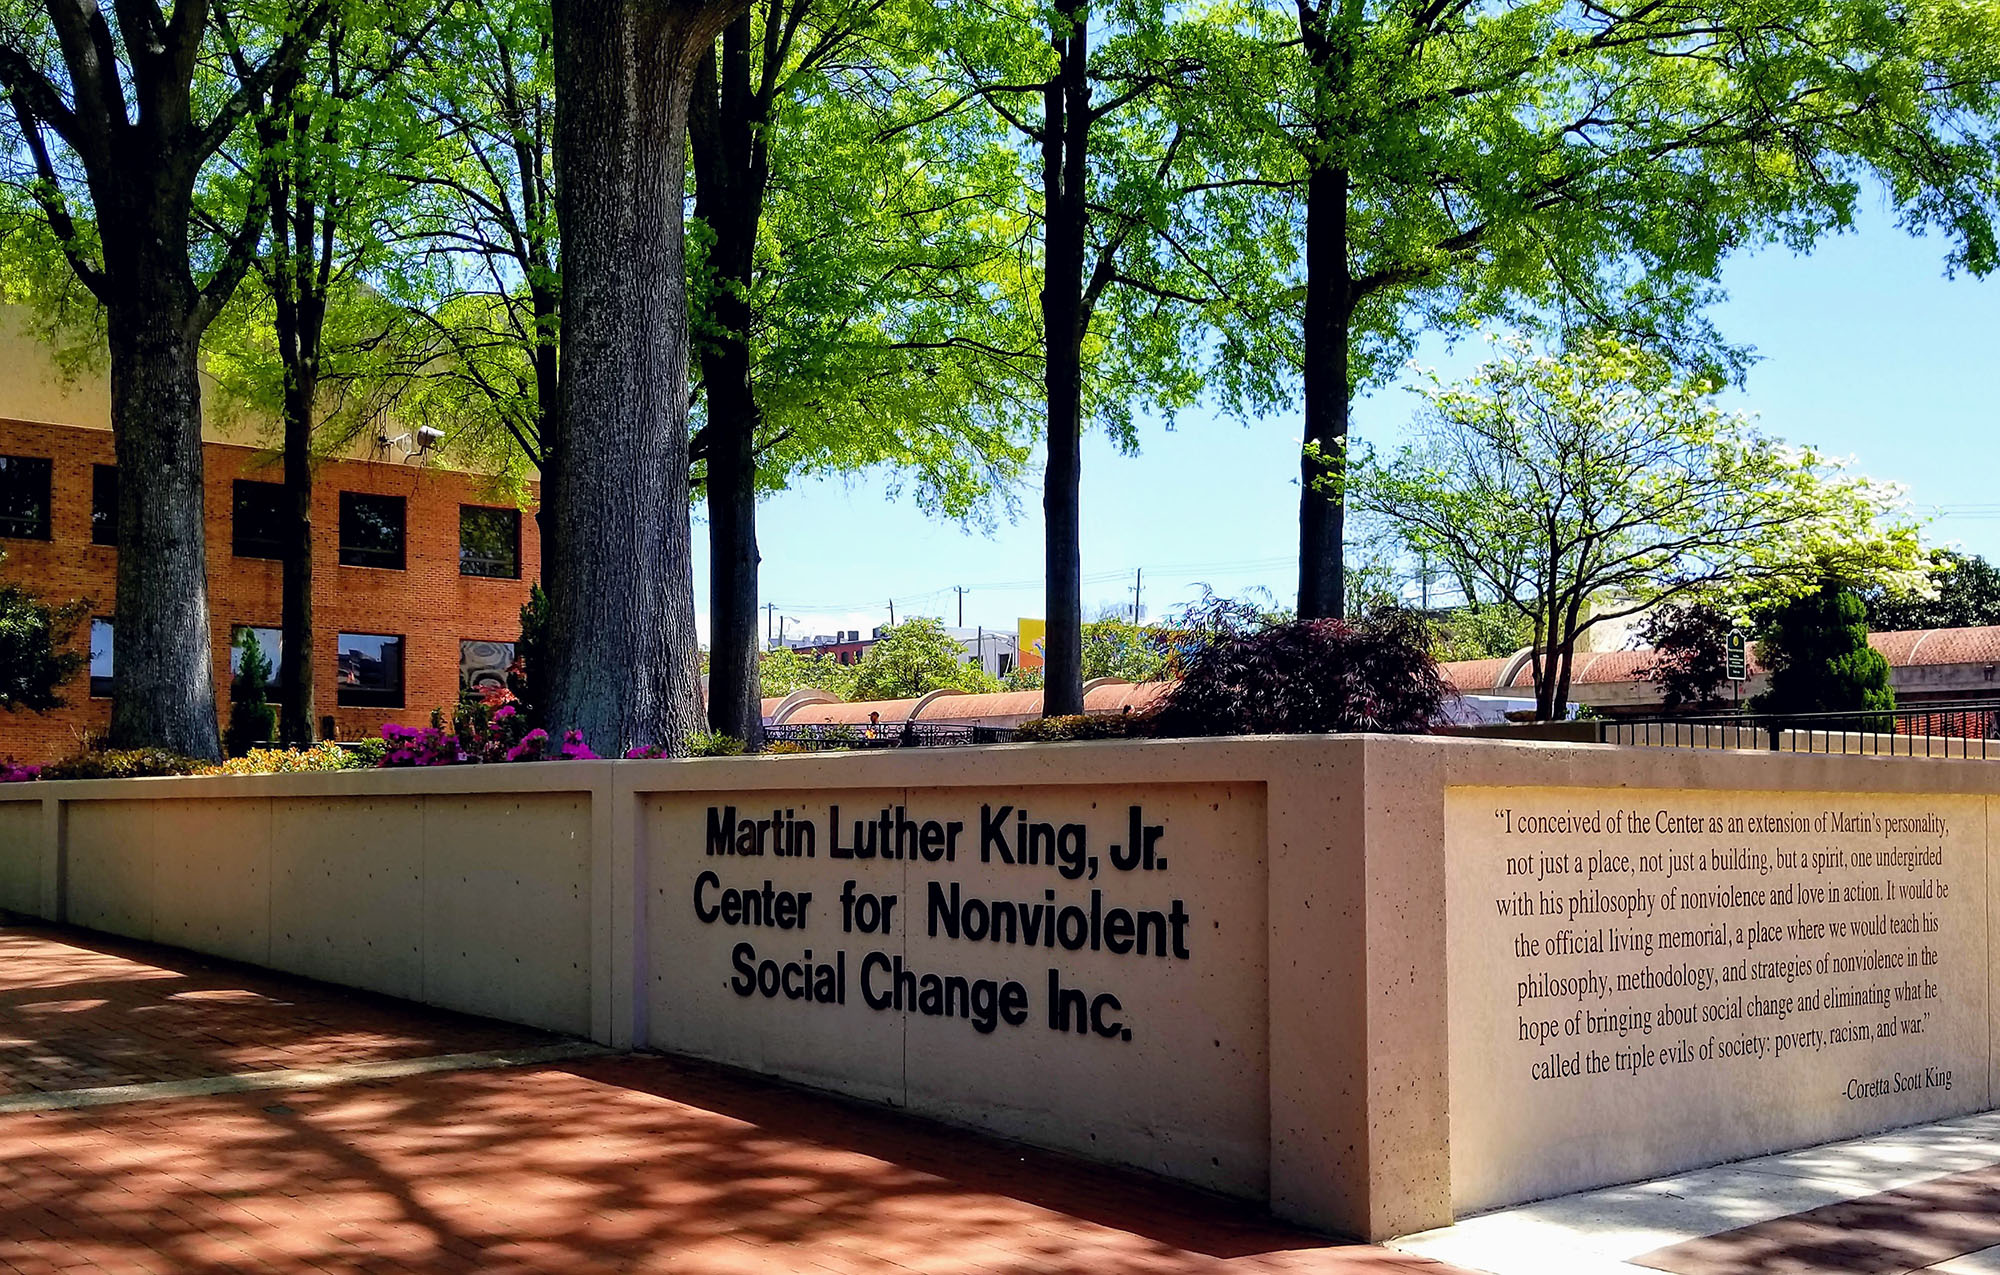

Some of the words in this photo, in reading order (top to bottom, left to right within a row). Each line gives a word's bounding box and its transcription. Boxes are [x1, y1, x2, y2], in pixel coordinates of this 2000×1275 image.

[706, 806, 815, 858] Martin
[829, 805, 963, 861] Luther
[980, 804, 1099, 880] King,
[1110, 806, 1168, 871] Jr.
[1517, 810, 1600, 834] conceived
[1606, 810, 1623, 834] of
[1627, 811, 1651, 834] the
[1655, 810, 1704, 834] Center
[1709, 817, 1724, 834] as
[1728, 816, 1744, 833] an
[1748, 811, 1810, 833] extension
[1814, 811, 1828, 833] of
[1885, 812, 1949, 838] personality,
[1506, 854, 1534, 875] not
[1537, 850, 1569, 881] just
[1574, 857, 1583, 874] a
[1588, 850, 1635, 880] place,
[1639, 852, 1663, 873] not
[1667, 849, 1694, 878] just
[1699, 855, 1707, 871] a
[1711, 848, 1773, 875] building,
[1776, 847, 1797, 869] but
[1801, 853, 1808, 869] a
[1812, 846, 1848, 874] spirit,
[1851, 851, 1872, 867] one
[1876, 846, 1942, 871] undergirded
[694, 870, 812, 930] Center
[840, 880, 897, 934] for
[928, 881, 1190, 960] Nonviolent
[1496, 891, 1534, 916] with
[1539, 890, 1563, 915] his
[1568, 888, 1656, 921] philosophy
[1660, 887, 1677, 910] of
[1680, 885, 1765, 909] nonviolence
[1770, 883, 1793, 905] and
[1798, 883, 1825, 904] love
[1828, 881, 1840, 903] in
[1843, 880, 1883, 902] action.
[1887, 880, 1896, 900] It
[1899, 879, 1933, 900] would
[1936, 879, 1949, 899] be
[1514, 933, 1540, 957] the
[1545, 929, 1604, 956] official
[1609, 927, 1653, 956] living
[1658, 923, 1733, 949] memorial,
[1736, 927, 1744, 944] a
[1748, 920, 1783, 950] place
[1787, 918, 1825, 940] where
[1829, 921, 1847, 937] we
[1850, 914, 1887, 936] would
[1890, 913, 1919, 934] teach
[1922, 912, 1939, 932] his
[731, 942, 846, 1005] Social
[860, 951, 1028, 1034] Change
[1048, 968, 1132, 1042] Inc.
[1517, 969, 1612, 1007] philosophy,
[1617, 962, 1719, 992] methodology,
[1722, 959, 1747, 982] and
[1751, 954, 1812, 983] strategies
[1816, 952, 1830, 974] of
[1833, 949, 1904, 973] nonviolence
[1907, 947, 1918, 967] in
[1921, 946, 1938, 966] the
[1518, 1016, 1560, 1046] hope
[1564, 1010, 1583, 1036] of
[1586, 1006, 1652, 1038] bringing
[1657, 1003, 1698, 1027] about
[1702, 997, 1742, 1022] social
[1747, 994, 1793, 1020] change
[1797, 989, 1820, 1011] and
[1824, 983, 1891, 1009] eliminating
[1895, 980, 1921, 1001] what
[1924, 979, 1938, 999] he
[1531, 1051, 1581, 1081] called
[1586, 1049, 1610, 1074] the
[1615, 1044, 1655, 1076] triple
[1659, 1039, 1694, 1065] evils
[1699, 1036, 1715, 1061] of
[1719, 1033, 1771, 1060] society:
[1775, 1028, 1827, 1057] poverty,
[1829, 1020, 1874, 1045] racism,
[1876, 1016, 1897, 1038] and
[1842, 1078, 1890, 1101] -Coretta
[1893, 1071, 1922, 1094] Scott
[1925, 1066, 1953, 1090] King
